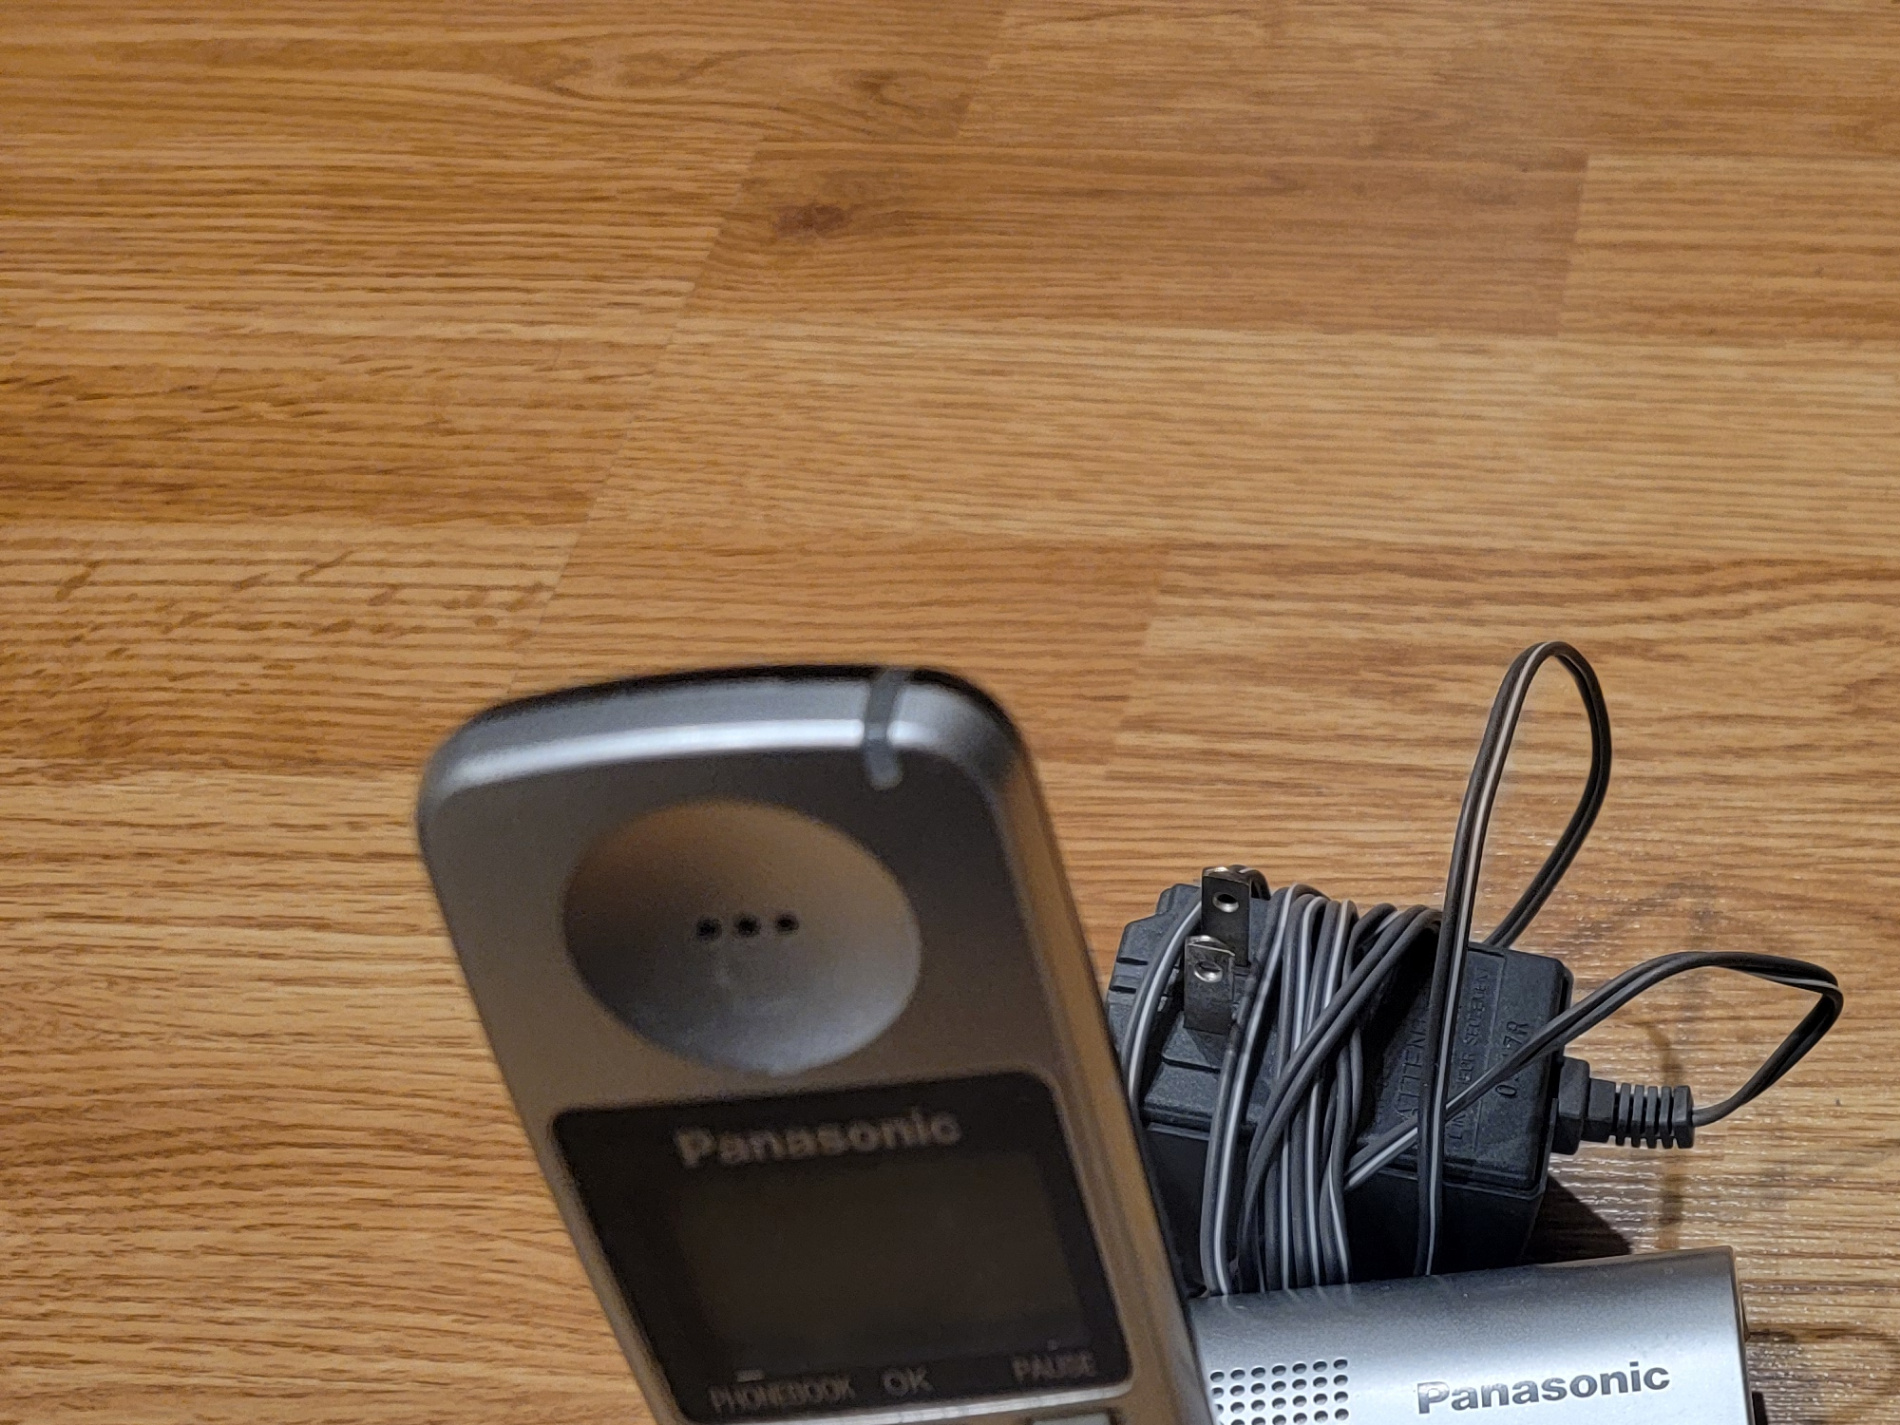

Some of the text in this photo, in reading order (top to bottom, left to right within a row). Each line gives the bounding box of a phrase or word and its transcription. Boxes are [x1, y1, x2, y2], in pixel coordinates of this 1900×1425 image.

[674, 1106, 963, 1168] Panasonic
[882, 1365, 936, 1397] OK
[1417, 1361, 1670, 1414] Panasonic
